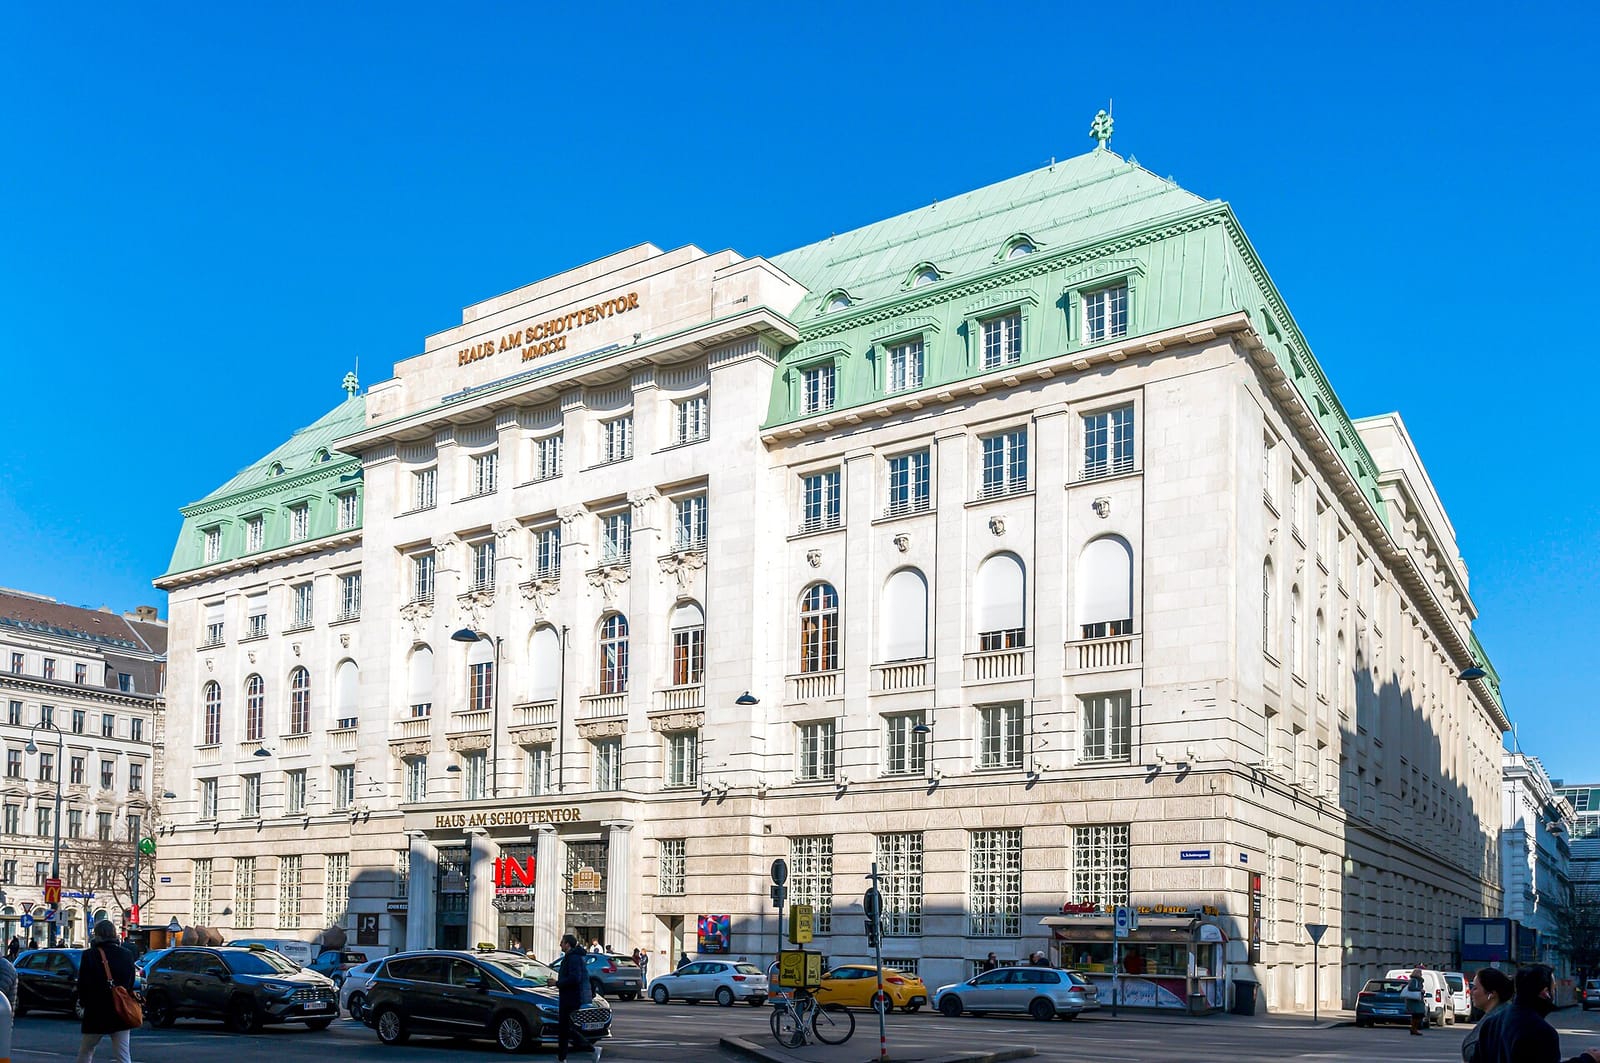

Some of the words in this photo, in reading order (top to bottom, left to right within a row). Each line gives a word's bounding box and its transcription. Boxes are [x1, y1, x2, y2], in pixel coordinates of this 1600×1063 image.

[458, 340, 495, 367] HAUS
[498, 331, 522, 354] AM
[525, 292, 640, 344] SCHOTTENTOR
[521, 335, 567, 363] MMXXI
[436, 814, 466, 828] HAUS
[468, 813, 488, 827] AM
[490, 808, 581, 825] SCHOTTENTOR
[495, 855, 536, 887] IN
[361, 914, 376, 932] JR
